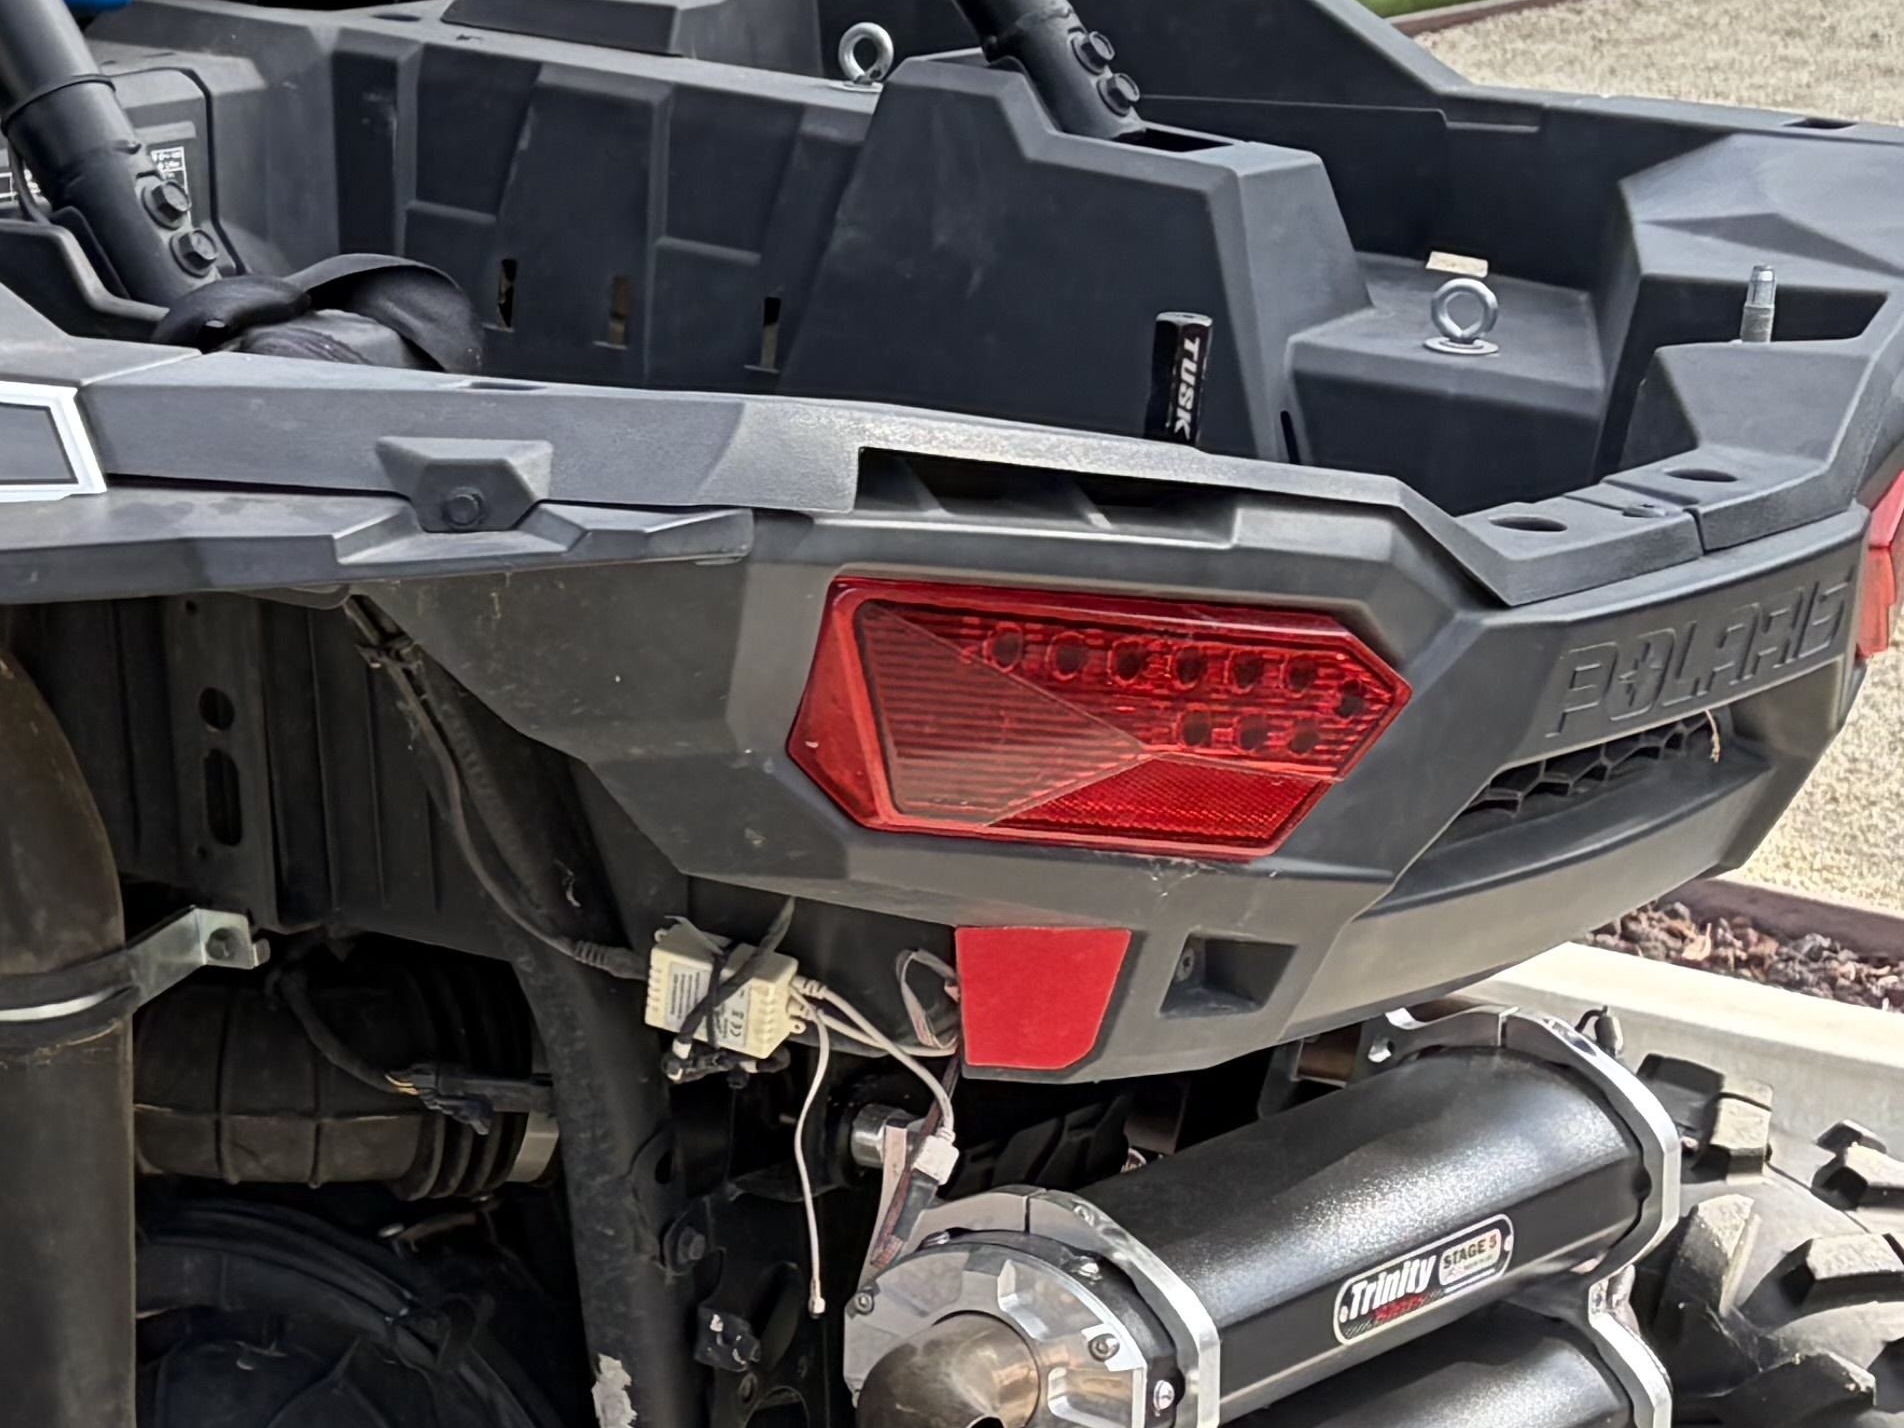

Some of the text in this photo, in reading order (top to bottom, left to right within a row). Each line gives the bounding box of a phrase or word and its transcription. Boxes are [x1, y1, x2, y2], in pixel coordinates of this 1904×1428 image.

[1173, 336, 1201, 441] TUSK
[1545, 566, 1856, 738] POLARIS
[1349, 1254, 1437, 1321] Trinity
[1443, 1238, 1487, 1269] STAGE
